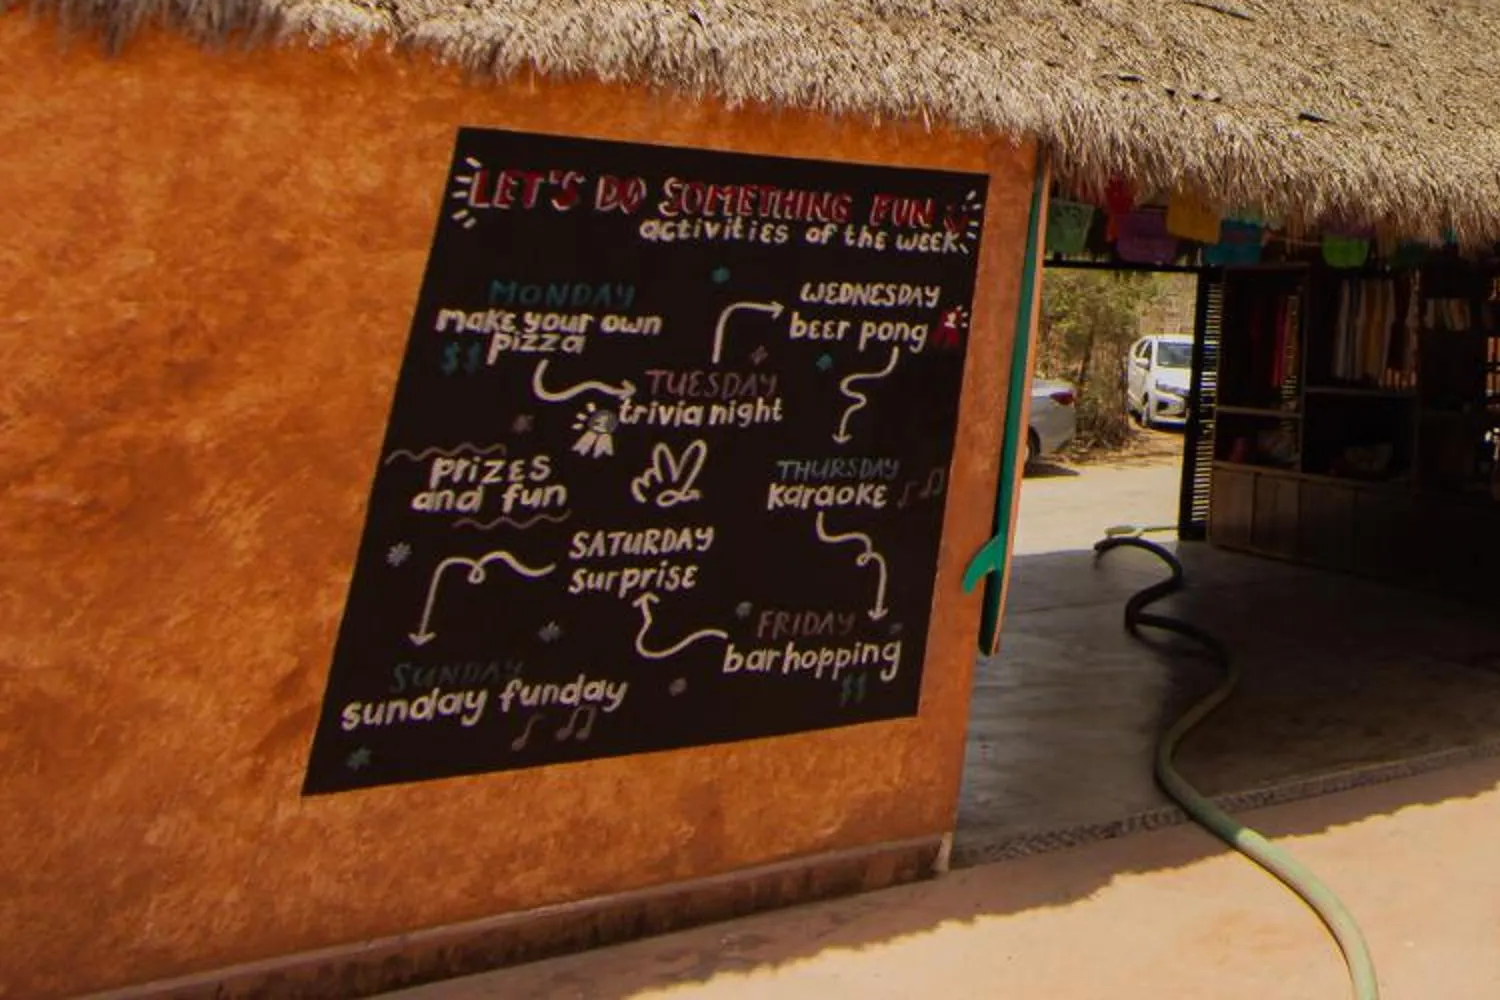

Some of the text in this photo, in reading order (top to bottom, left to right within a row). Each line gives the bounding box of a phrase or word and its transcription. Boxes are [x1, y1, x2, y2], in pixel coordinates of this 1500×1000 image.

[594, 174, 648, 214] DO
[656, 175, 853, 222] SOMETHING
[869, 192, 935, 229] FUN
[639, 216, 789, 244] activities
[805, 222, 836, 246] of
[843, 223, 889, 250] the
[488, 279, 636, 307] MONDAY
[800, 281, 941, 308] WEDNESDAY
[434, 307, 664, 337] make your own
[789, 311, 928, 352] beer pong
[486, 331, 588, 366] pizza
[644, 369, 779, 399] TUESDAY
[617, 397, 784, 428] trivia night
[429, 455, 552, 489] prizes
[775, 457, 901, 482] THURSDAY
[411, 481, 567, 513] and fun
[569, 525, 715, 559] SATURDAY
[757, 609, 856, 639] FRIDAY
[389, 659, 526, 693] SUNDAY
[340, 673, 629, 731] sunday funday
